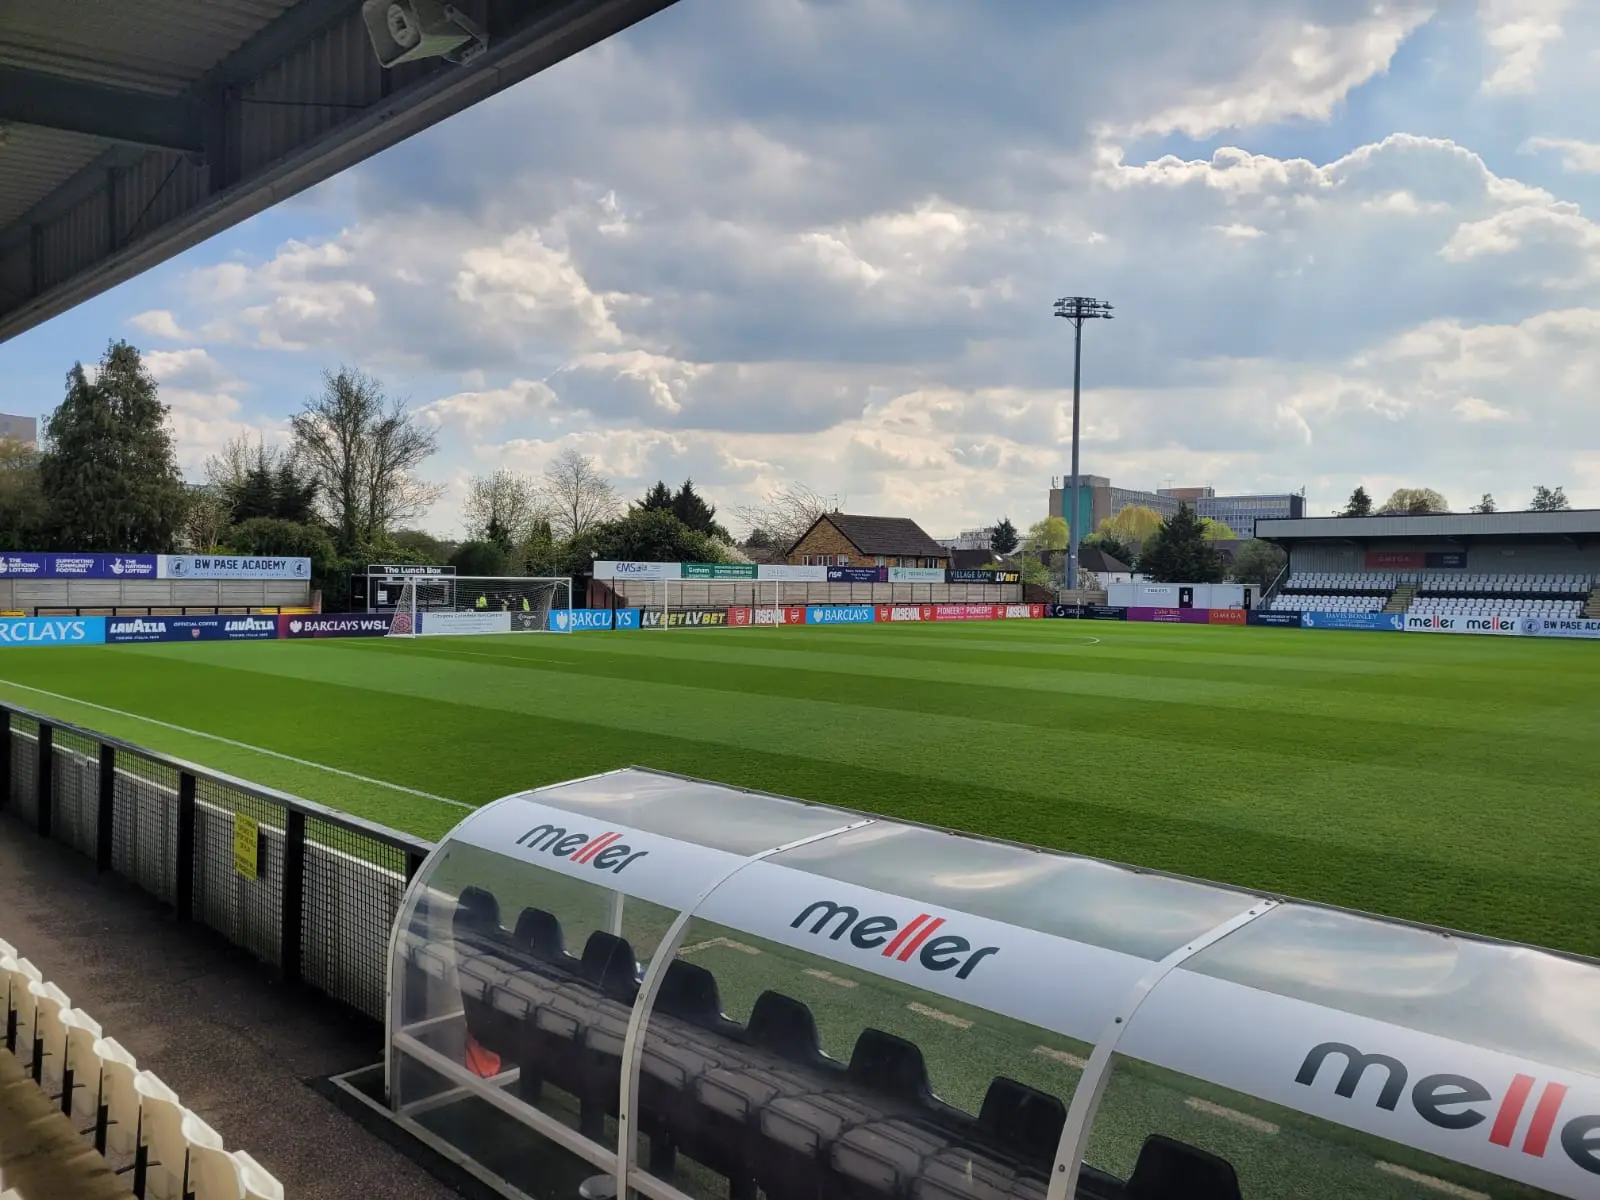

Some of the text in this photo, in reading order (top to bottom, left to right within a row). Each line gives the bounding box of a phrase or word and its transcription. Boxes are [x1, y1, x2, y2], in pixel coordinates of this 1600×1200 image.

[194, 559, 287, 571] BW PASE ACADEMY
[384, 566, 400, 574] The
[401, 566, 425, 574] Lunch
[950, 571, 975, 579] VILLAGE
[824, 609, 869, 621] BARCLAYS
[891, 607, 921, 621] ARSENAL
[1006, 606, 1030, 618] ARSENAL
[110, 618, 167, 634] LAVAZZA
[224, 617, 275, 631] LAVAZZA
[304, 619, 389, 632] BARCLAYS WSL
[1409, 616, 1515, 631] meller meller
[1543, 620, 1559, 630] BW
[1560, 622, 1582, 631] PASE
[515, 824, 649, 874] meller
[790, 900, 1000, 980] meller
